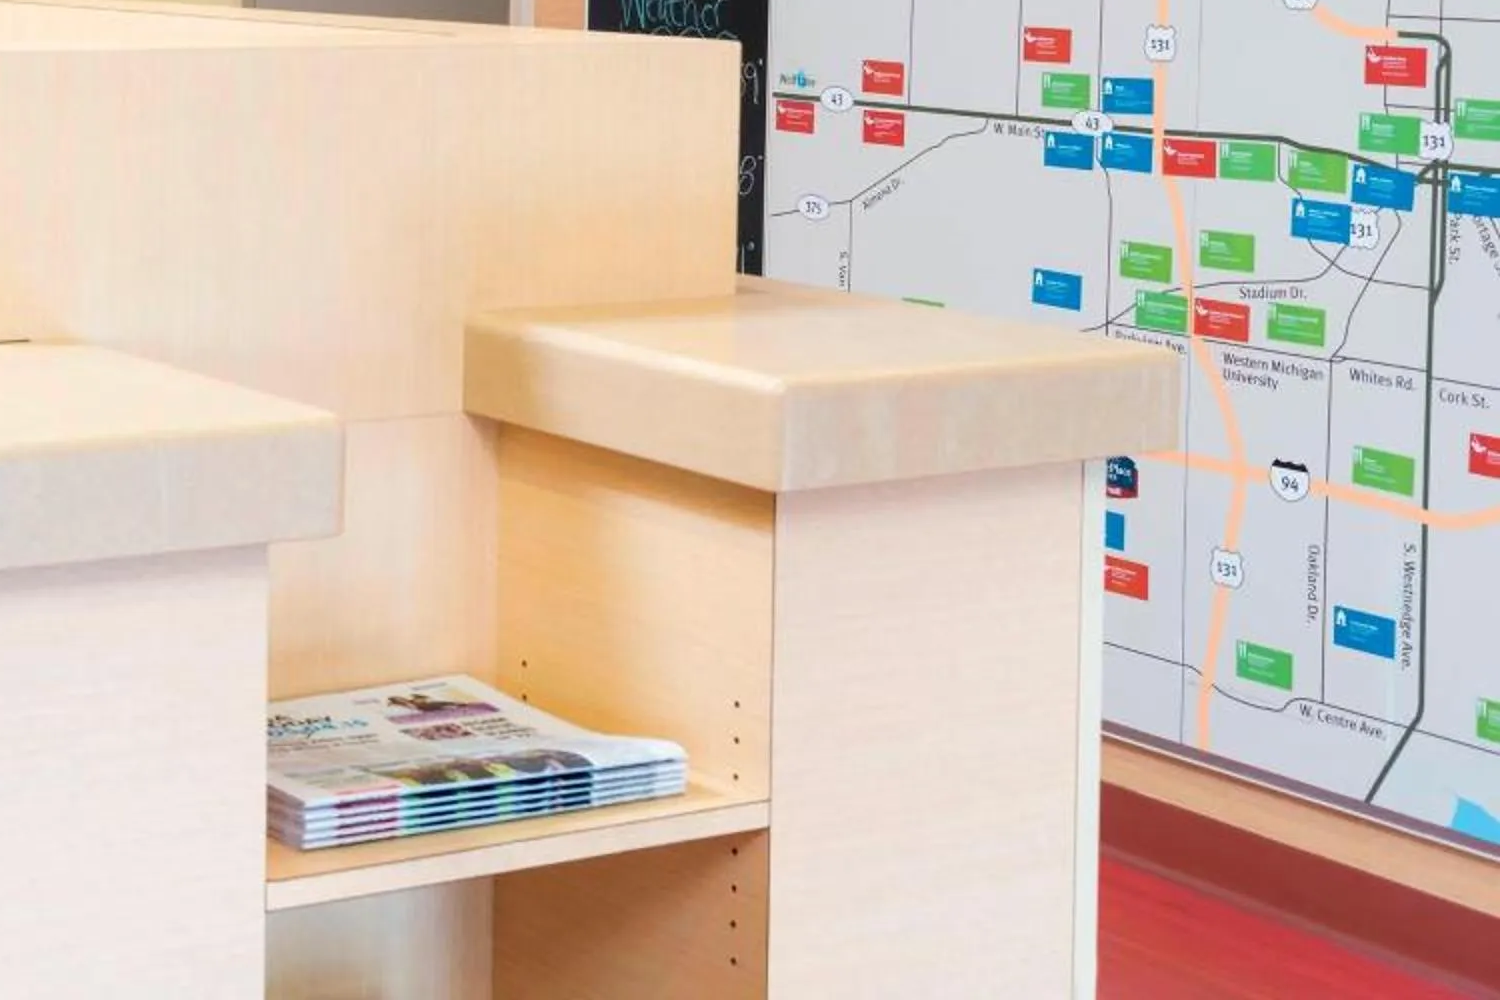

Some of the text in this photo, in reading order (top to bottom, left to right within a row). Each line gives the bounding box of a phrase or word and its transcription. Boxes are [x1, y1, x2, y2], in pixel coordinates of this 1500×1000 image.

[1151, 39, 1170, 51] 131
[831, 94, 843, 105] 43
[1008, 124, 1031, 136] Main
[1085, 116, 1100, 131] 43
[1423, 135, 1445, 150] 131
[1351, 223, 1372, 239] 131
[1448, 213, 1461, 265] ark St.
[1239, 285, 1307, 300] Stadium Dr.
[1223, 353, 1324, 381] Western Michigan
[1222, 368, 1279, 390] University
[1349, 367, 1418, 391] Whites Rd.
[1439, 388, 1491, 409] Cork St.
[1281, 475, 1298, 492] 94
[1217, 561, 1237, 577] 131
[1307, 544, 1320, 625] Oakland Dr.
[1401, 543, 1417, 671] S. Westnedge Ave.
[1318, 709, 1357, 730] Centre
[1359, 721, 1387, 741] Ave.
